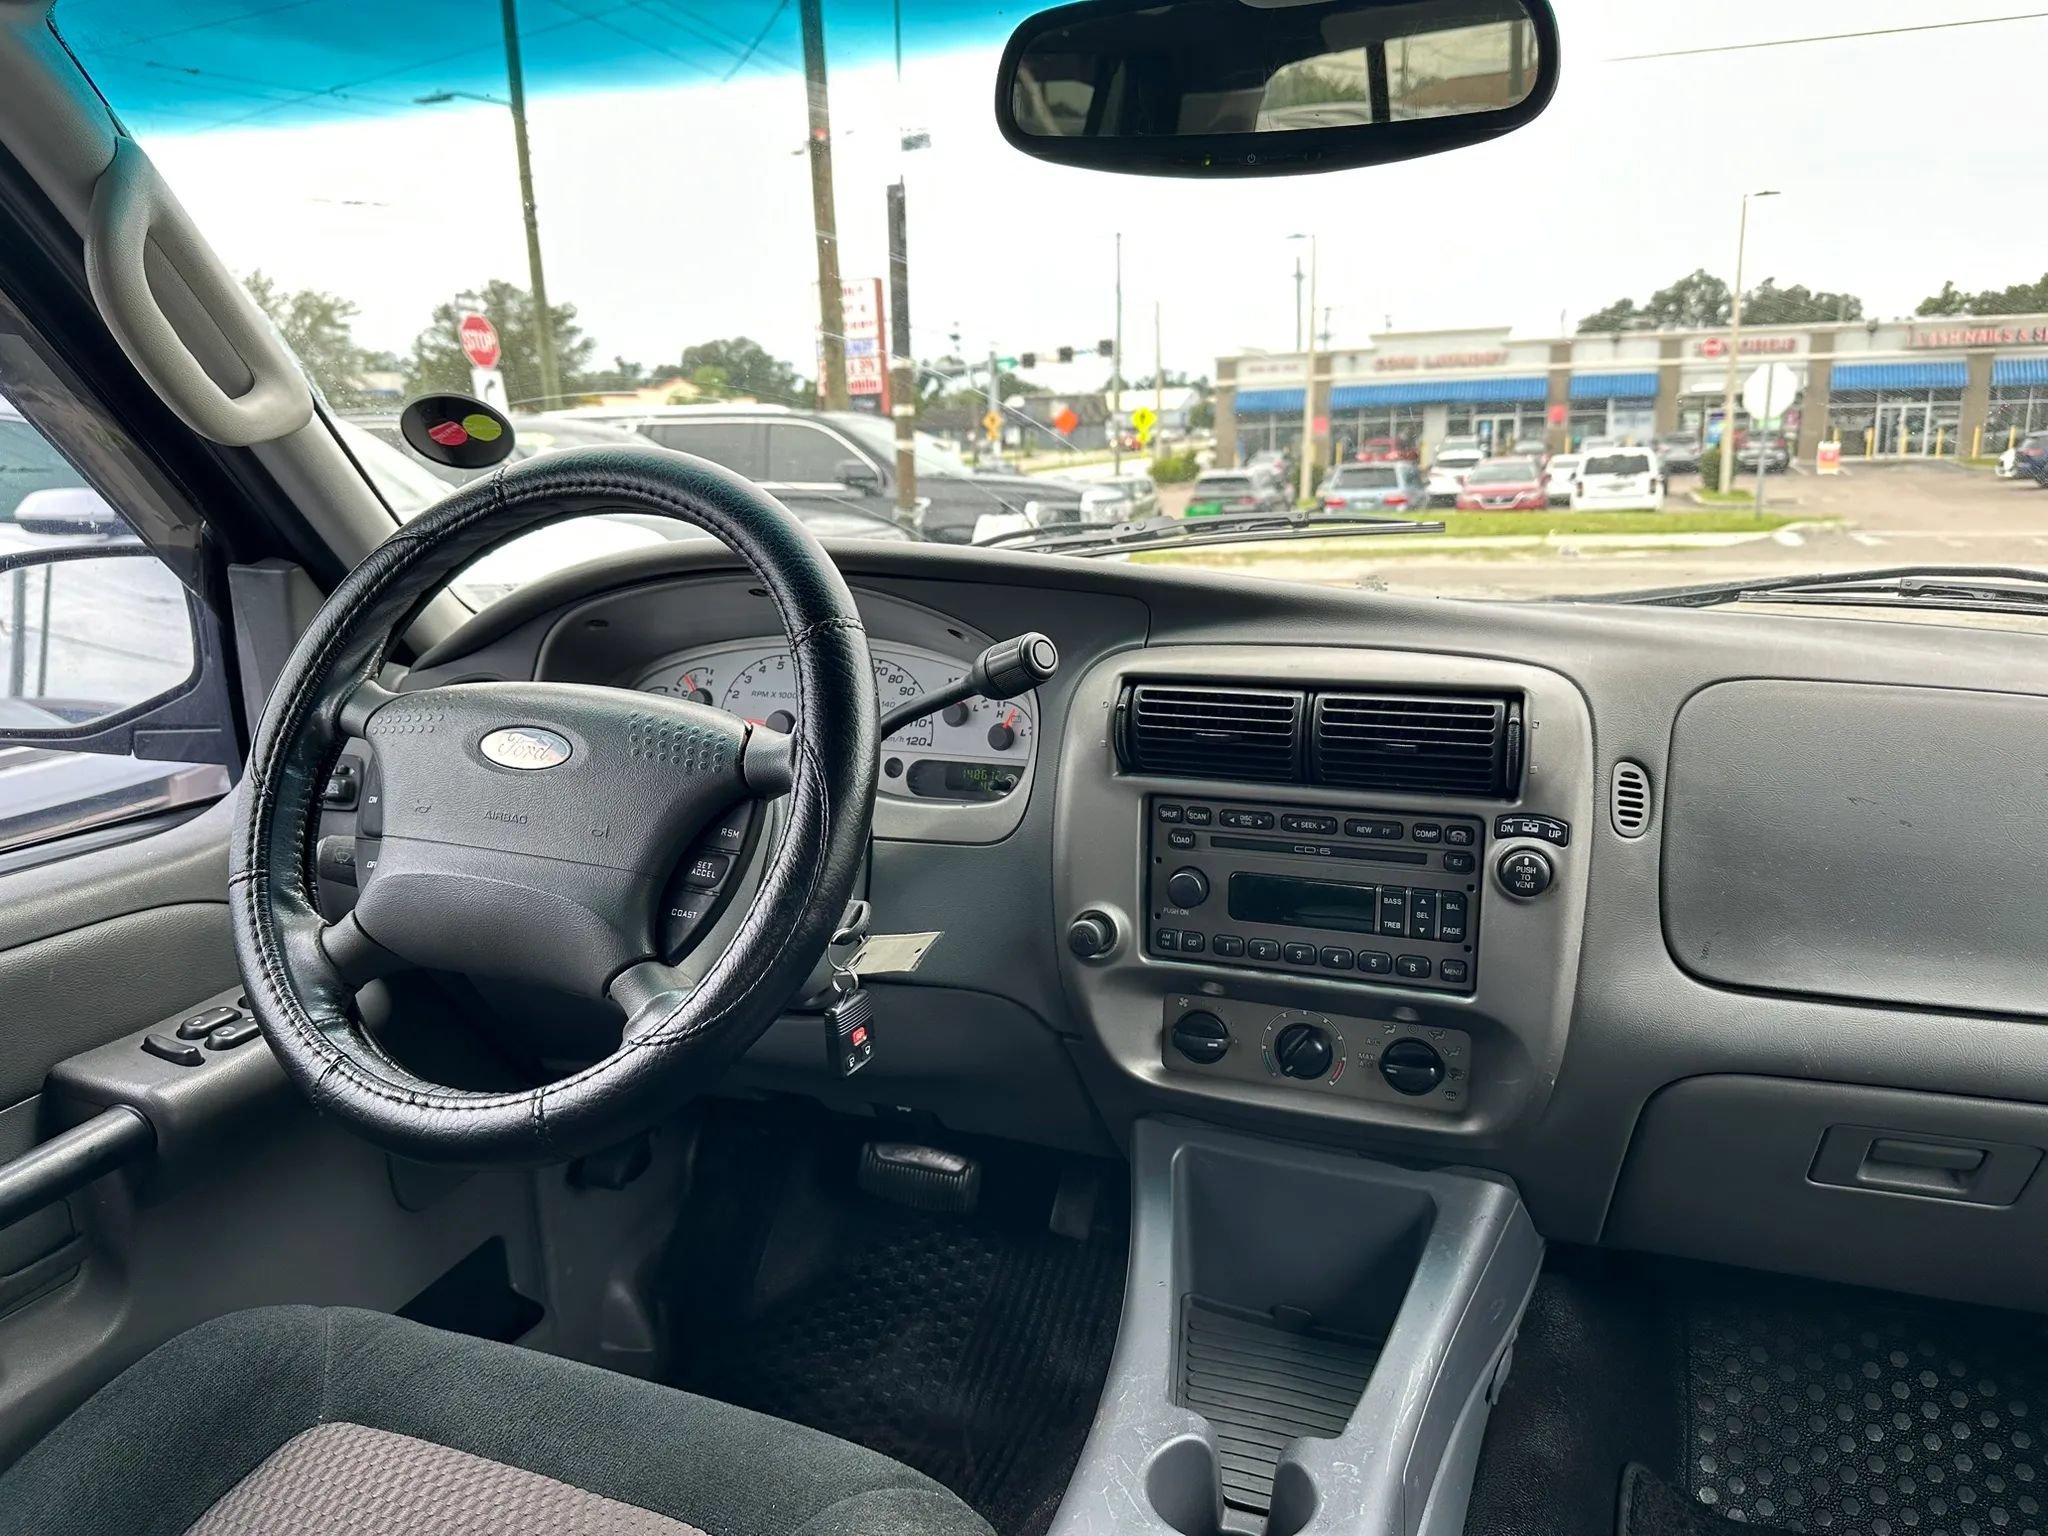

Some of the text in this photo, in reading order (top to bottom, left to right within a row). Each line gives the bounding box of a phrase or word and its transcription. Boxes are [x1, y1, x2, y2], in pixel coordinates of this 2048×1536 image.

[463, 330, 497, 351] STOP
[758, 664, 767, 674] 4
[776, 660, 786, 670] 5
[743, 675, 753, 685] 3
[887, 674, 904, 684] 80
[731, 690, 741, 700] 2
[751, 690, 770, 698] RPM
[899, 686, 916, 696] 90
[905, 736, 928, 747] 120
[497, 732, 555, 762] Ford
[368, 796, 379, 804] ON
[1161, 810, 1178, 819] SHUF
[1188, 812, 1207, 821] SCAN
[1300, 821, 1318, 830] SEEK
[1356, 826, 1373, 834] REW
[720, 827, 740, 839] RSM
[1415, 829, 1438, 839] COMP
[1500, 824, 1562, 838] DN UP
[1173, 836, 1190, 844] LOAD
[696, 860, 713, 870] SET
[1515, 865, 1537, 875] PUSH
[690, 868, 716, 879] ACCEL
[1520, 874, 1531, 882] TO
[1515, 881, 1536, 889] VENT
[1383, 897, 1402, 905] BASS
[1446, 903, 1460, 911] BAL
[671, 908, 698, 919] COAST
[1416, 911, 1430, 920] SEL
[1383, 920, 1401, 929] TREB
[1442, 926, 1461, 935] FADE
[1260, 946, 1266, 956] 2
[1296, 950, 1302, 960] 3
[1333, 954, 1339, 964] 4
[1370, 958, 1377, 968] 5
[1409, 963, 1416, 973] 6
